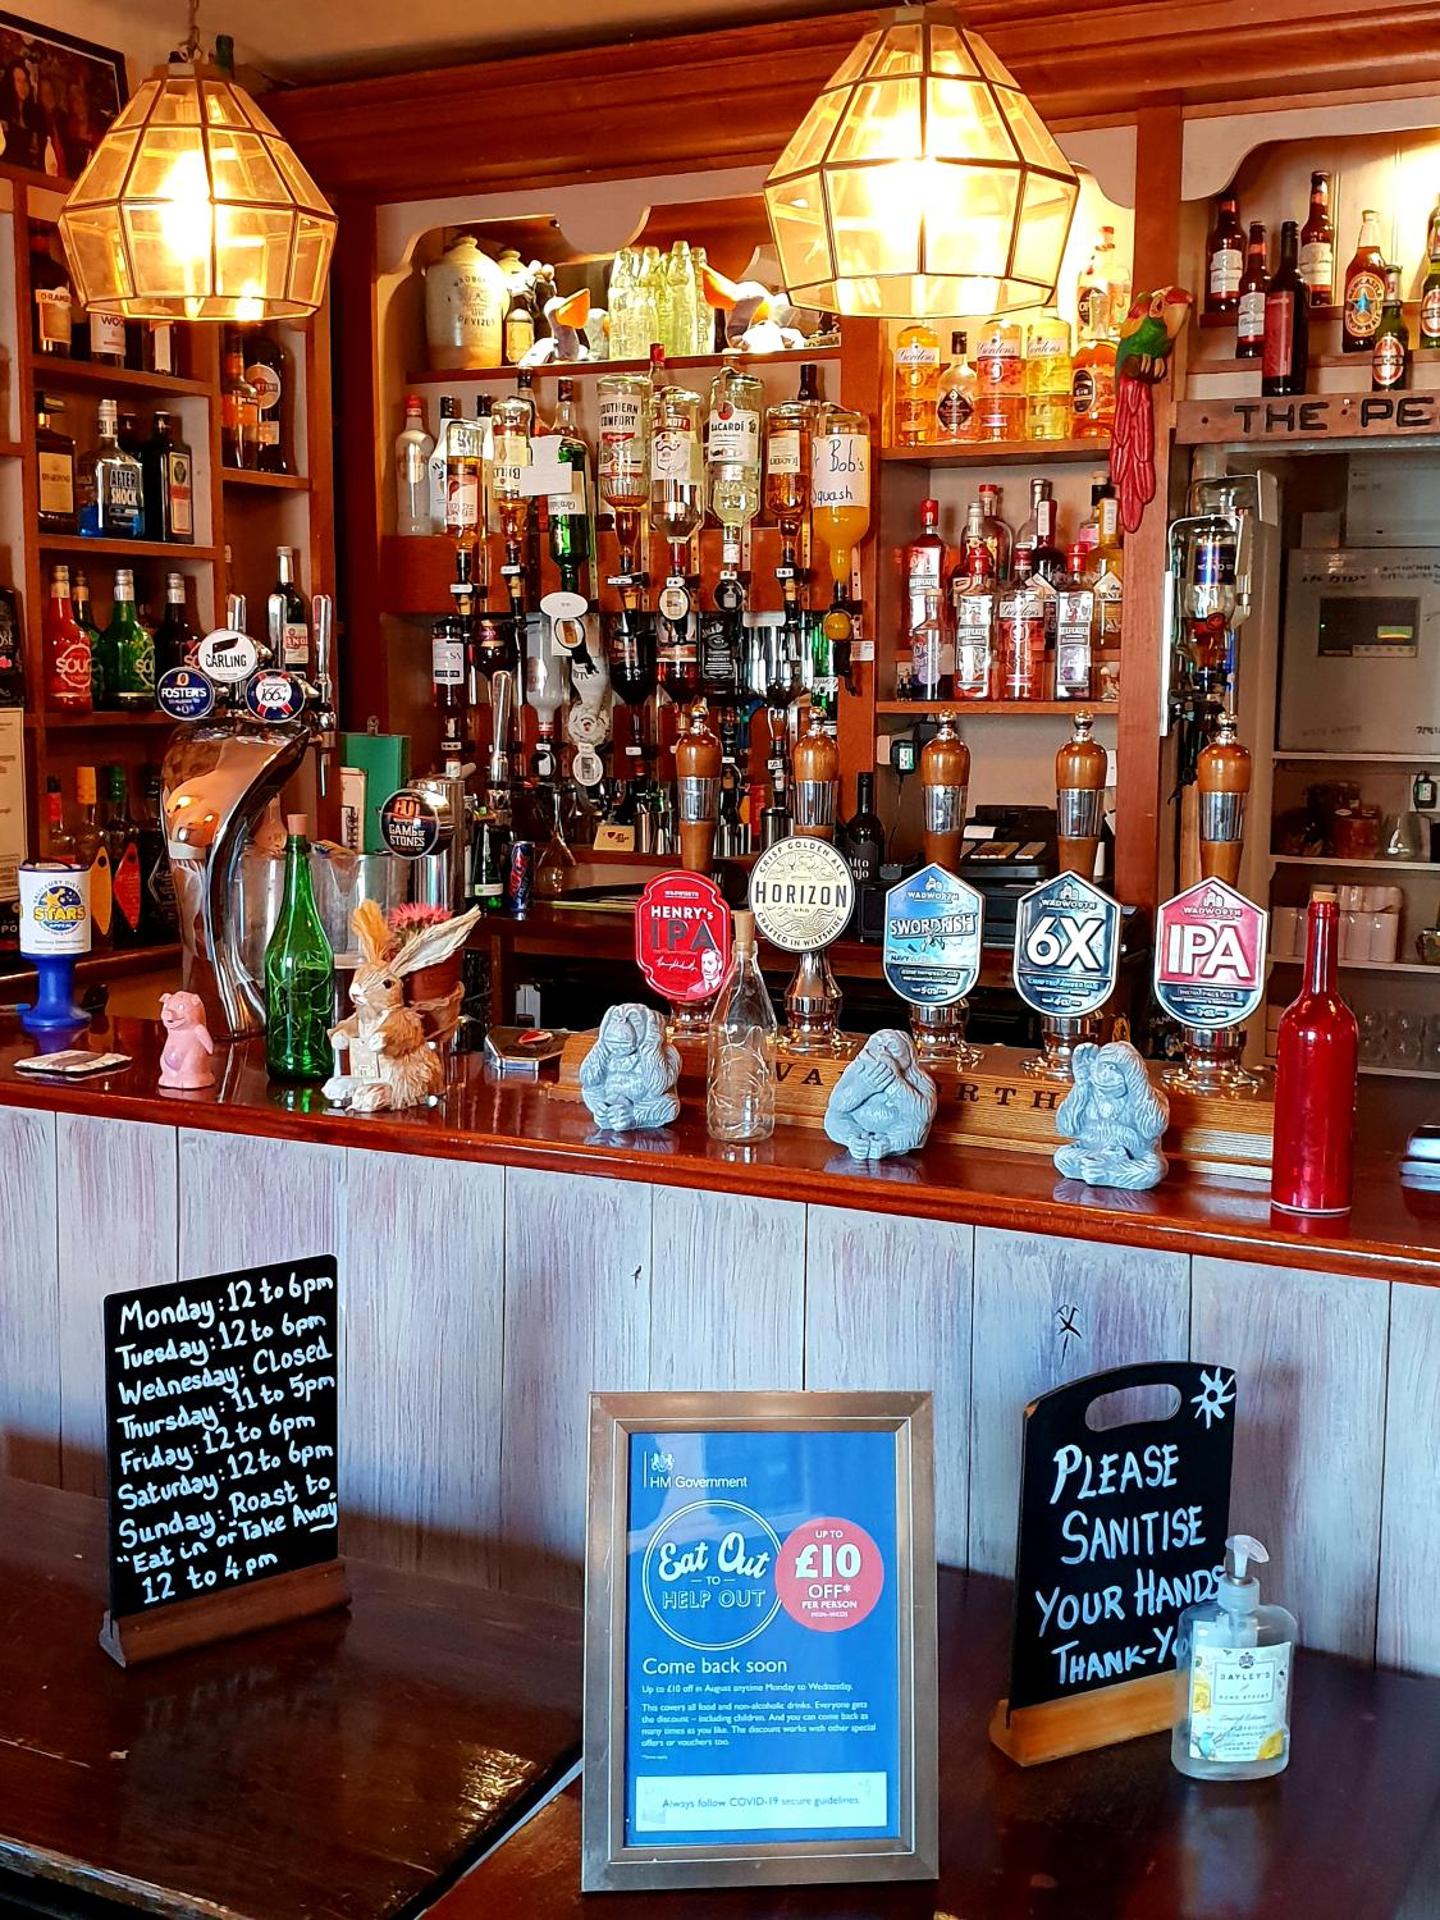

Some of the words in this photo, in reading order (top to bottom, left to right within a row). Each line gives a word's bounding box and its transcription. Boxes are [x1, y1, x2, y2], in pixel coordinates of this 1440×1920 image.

[1234, 402, 1329, 433] THE
[828, 438, 865, 473] Bob's
[110, 470, 136, 488] AFTER
[111, 488, 138, 506] SHOCK
[205, 653, 247, 668] CARLING
[389, 836, 425, 847] STONES
[759, 846, 783, 873] CRISP
[788, 841, 830, 857] GOLDEN
[831, 858, 846, 877] ALE
[755, 881, 847, 908] HORIZON
[907, 891, 959, 901] WADWORTH
[1040, 899, 1097, 910] WADWORTH
[33, 905, 86, 921] STARS
[651, 905, 714, 920] HENRY's
[890, 913, 976, 935] SWORDFISH
[1183, 906, 1242, 918] WADWORTH
[651, 918, 718, 951] IPA
[757, 912, 789, 943] CRAFTED
[790, 938, 800, 946] IN
[803, 916, 844, 947] WILTSHIRE
[1026, 916, 1105, 971] 6X
[1167, 923, 1251, 979] IPA
[120, 1296, 224, 1334] Monday:
[227, 1279, 256, 1312] 12
[260, 1278, 284, 1301] to
[288, 1272, 334, 1305] 6pm
[219, 1319, 248, 1349] 12
[251, 1319, 273, 1340] to
[281, 1313, 327, 1340] 6pm
[253, 1337, 333, 1376] Closed
[231, 1385, 258, 1412] 11
[261, 1382, 284, 1404] to
[289, 1372, 336, 1402] 5pm
[202, 1428, 235, 1456] 12
[237, 1419, 262, 1444] to
[269, 1413, 316, 1443] 6pm
[227, 1452, 258, 1481] 12
[258, 1448, 281, 1471] to
[288, 1442, 334, 1470] 6pm
[1049, 1443, 1181, 1504] PLEASE
[650, 1476, 672, 1488] HM
[675, 1475, 748, 1489] Government
[229, 1480, 299, 1518] Roast
[305, 1473, 331, 1497] to
[181, 1541, 208, 1560] in
[216, 1531, 237, 1548] or
[815, 1530, 829, 1539] UP
[829, 1530, 843, 1539] TO
[1061, 1505, 1207, 1565] SANITISE
[658, 1540, 709, 1582] Eat
[717, 1531, 771, 1580] Out
[794, 1543, 862, 1579] £10
[141, 1576, 176, 1604] 12
[186, 1564, 217, 1590] to
[707, 1575, 721, 1586] TO
[662, 1590, 712, 1610] HELP
[719, 1589, 766, 1609] OUT
[802, 1601, 819, 1610] PER
[821, 1600, 858, 1610] PERSON
[1035, 1585, 1126, 1639] YOUR
[1133, 1564, 1227, 1617] HANDS
[642, 1657, 696, 1675] Come
[701, 1656, 740, 1674] back
[746, 1659, 788, 1674] soon
[641, 1685, 653, 1694] Up
[667, 1685, 681, 1693] £10
[682, 1684, 694, 1693] off
[705, 1684, 731, 1695] August
[733, 1683, 764, 1694] anytime
[765, 1683, 796, 1694] Monday
[641, 1715, 655, 1723] the
[656, 1714, 689, 1723] discount
[698, 1714, 732, 1724] including
[768, 1713, 785, 1721] And
[786, 1714, 801, 1723] you
[841, 1712, 859, 1720] back
[642, 1704, 658, 1712] This
[698, 1703, 716, 1711] food
[718, 1703, 732, 1711] and
[734, 1702, 785, 1711] non-alcoholic
[815, 1700, 850, 1711] Everyone
[852, 1701, 868, 1711] gets
[641, 1728, 662, 1737] many
[664, 1726, 685, 1735] times
[697, 1728, 712, 1737] you
[731, 1725, 747, 1734] The
[748, 1725, 781, 1733] discount
[783, 1724, 807, 1733] works
[808, 1724, 826, 1732] with
[827, 1724, 849, 1732] other
[851, 1723, 877, 1734] special
[641, 1739, 664, 1747] offers
[677, 1738, 713, 1747] vouchers
[662, 1799, 695, 1809] Always
[697, 1798, 726, 1808] follow
[728, 1796, 778, 1808] COVID-19
[782, 1798, 811, 1806] secure
